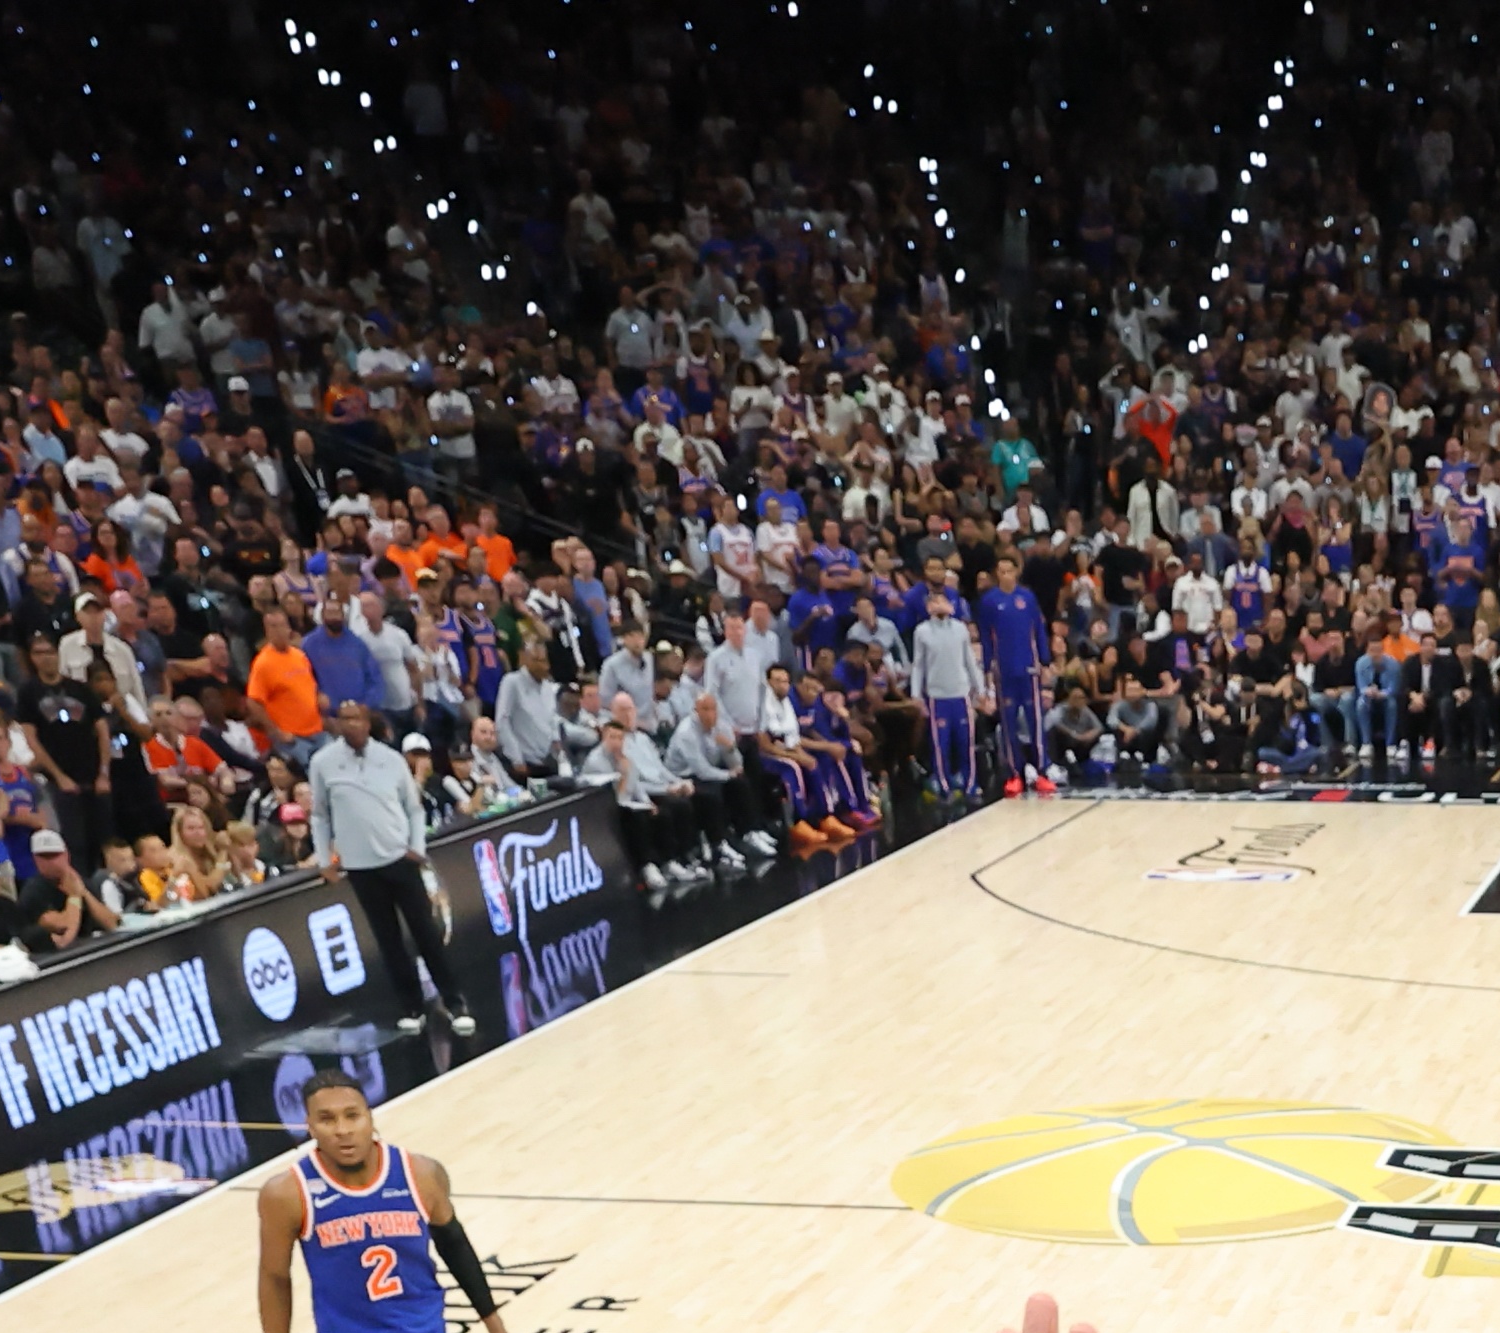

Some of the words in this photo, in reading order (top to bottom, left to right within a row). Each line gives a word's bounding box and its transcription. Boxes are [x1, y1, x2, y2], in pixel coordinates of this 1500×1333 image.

[500, 816, 603, 941] Finals
[250, 958, 290, 991] abc
[21, 956, 221, 1114] NECESSARY
[315, 1215, 366, 1249] NEW
[364, 1210, 423, 1240] YORK
[361, 1244, 404, 1302] 2
